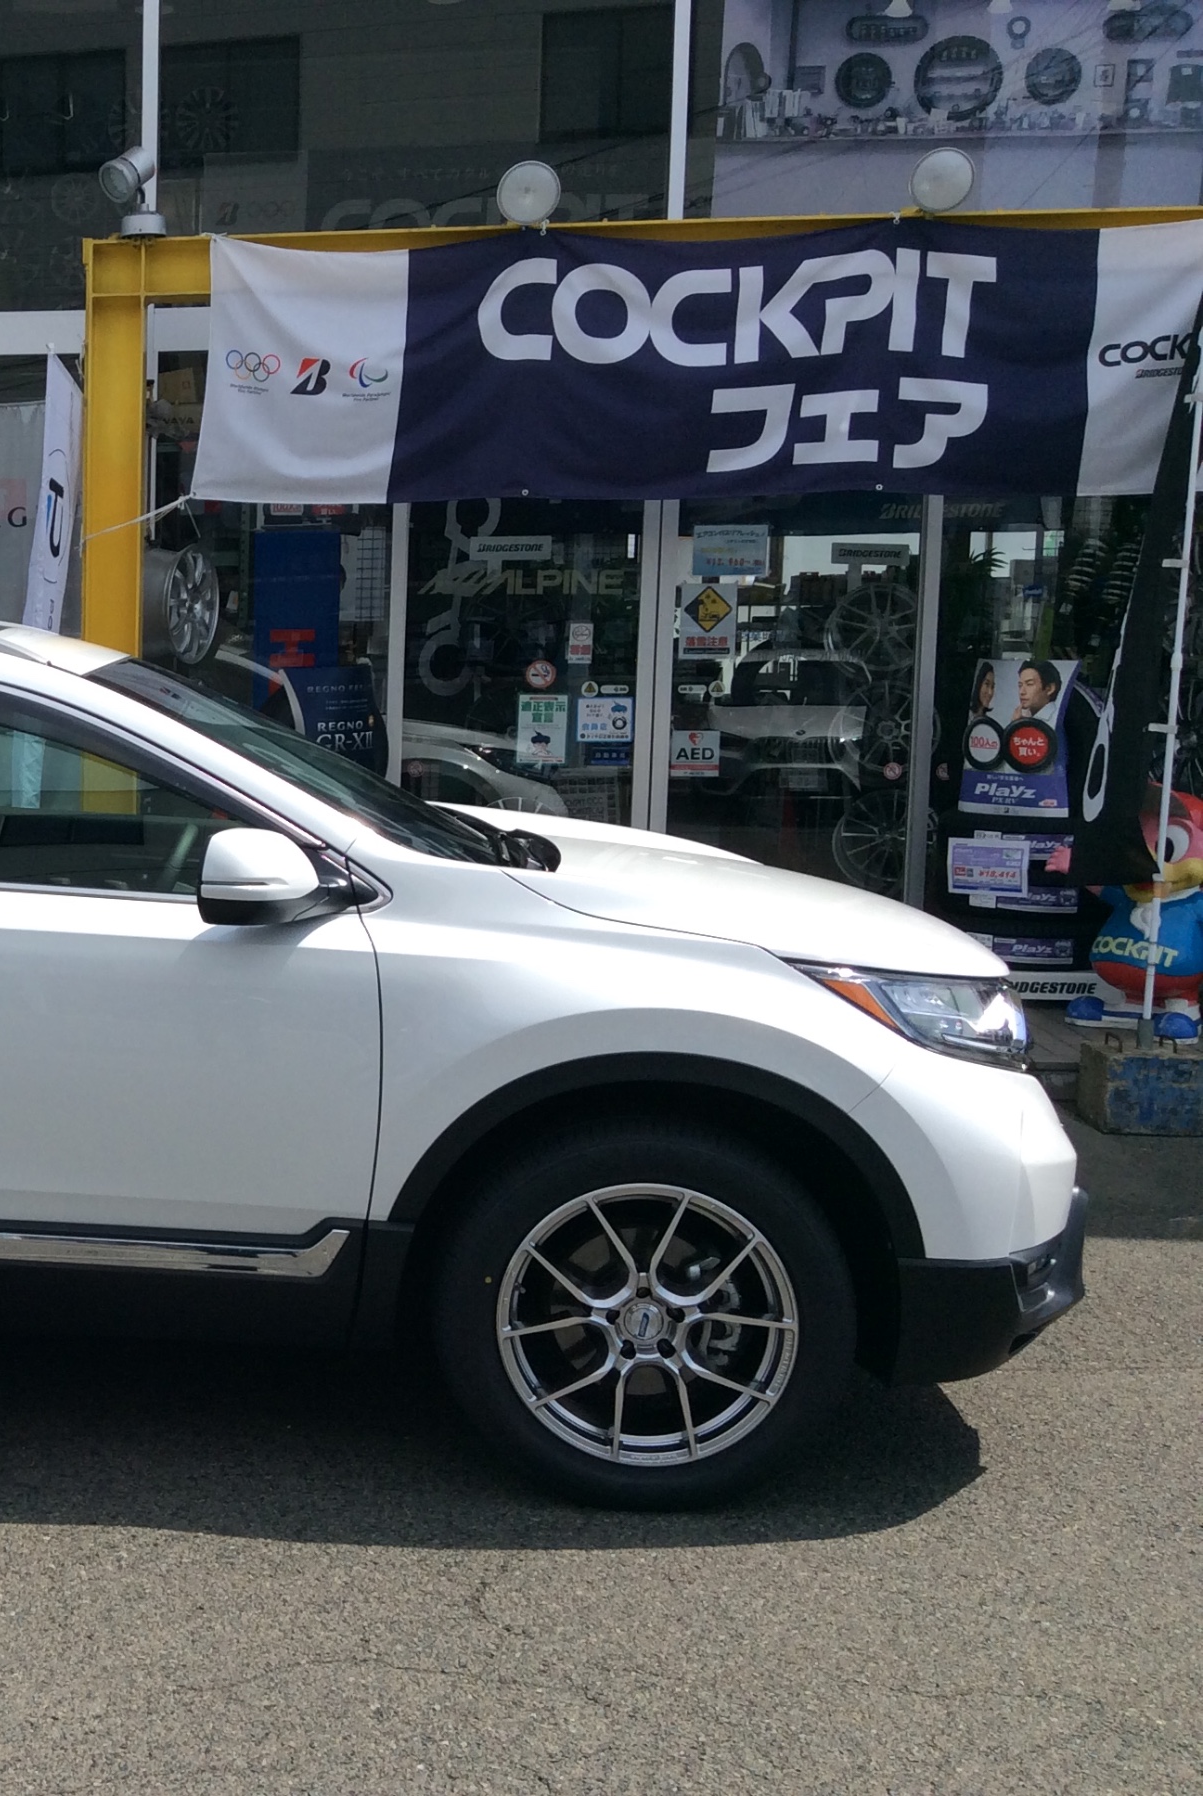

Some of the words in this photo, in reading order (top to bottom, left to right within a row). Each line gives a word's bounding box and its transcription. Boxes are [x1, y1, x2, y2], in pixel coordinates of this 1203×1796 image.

[477, 246, 999, 368] COCKPIT
[705, 376, 990, 474] フェア
[477, 543, 544, 553] BRIDGESTONE
[838, 548, 902, 559] BRIDGESTONE
[482, 568, 626, 595] ALPINE
[306, 685, 345, 693] REGNO
[317, 720, 363, 732] REGNO
[1013, 736, 1045, 747] ちゃんと
[675, 747, 715, 760] AED
[973, 782, 1037, 799] Playz
[1011, 943, 1053, 954] Playz
